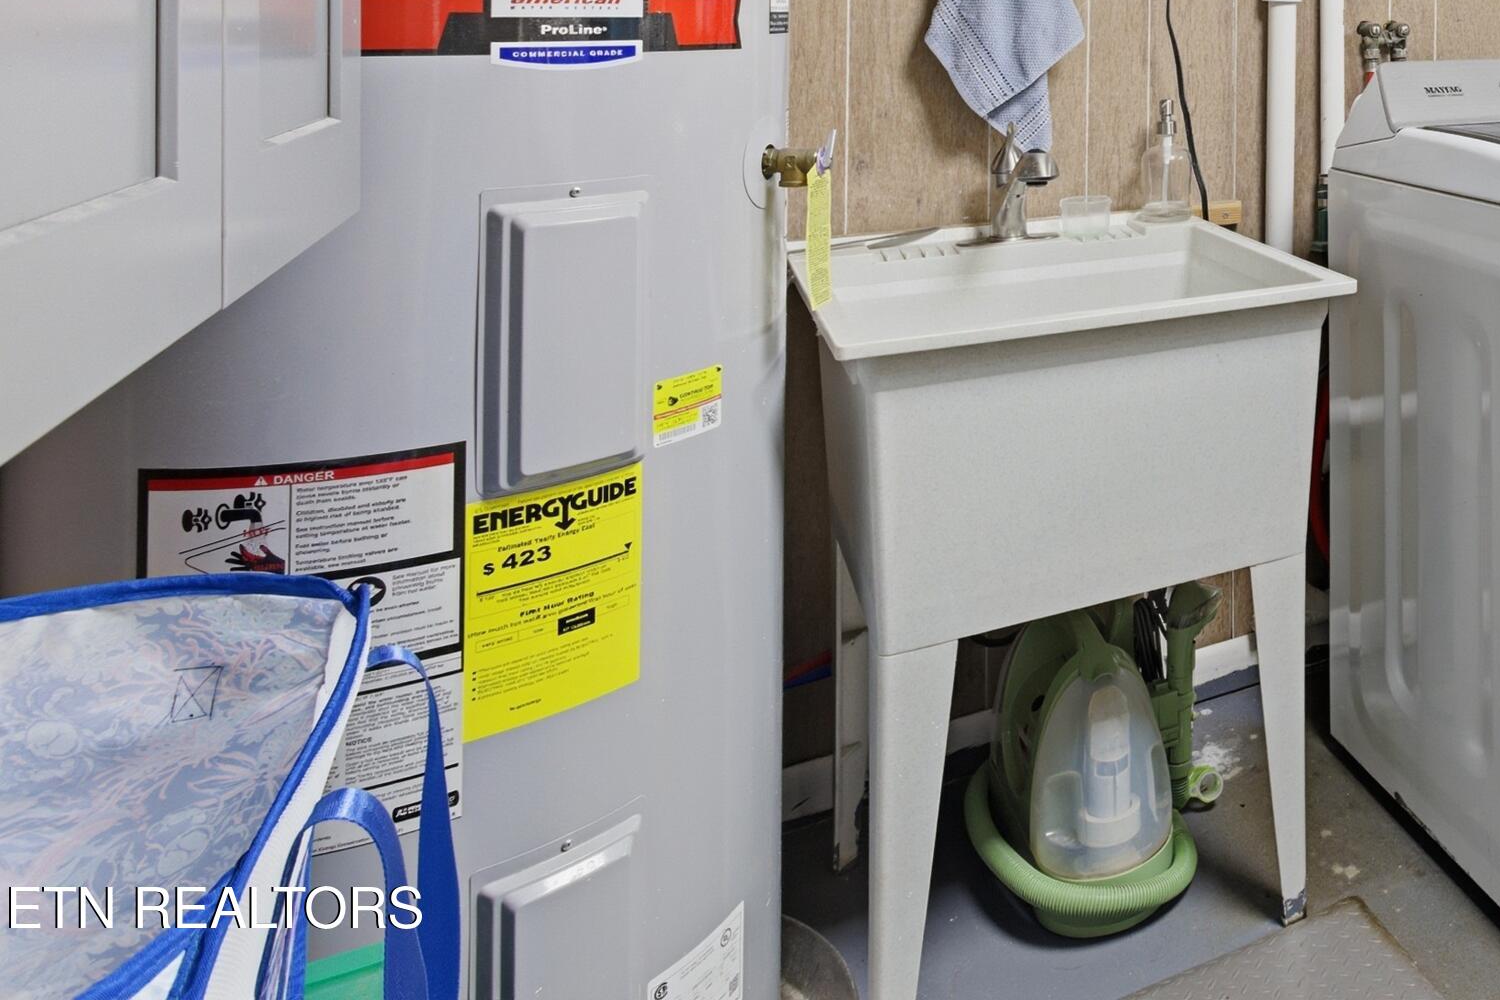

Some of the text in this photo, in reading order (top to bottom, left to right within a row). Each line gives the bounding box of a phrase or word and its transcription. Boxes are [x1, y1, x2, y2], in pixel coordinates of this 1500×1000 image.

[512, 50, 585, 58] COMMERCIAL
[1424, 86, 1462, 94] MAYTAG
[273, 470, 334, 484] DANGER
[473, 476, 637, 535] ENERGYGUIDE
[502, 545, 551, 570] 423
[567, 592, 595, 603] Rating
[345, 737, 372, 746] NOTICE
